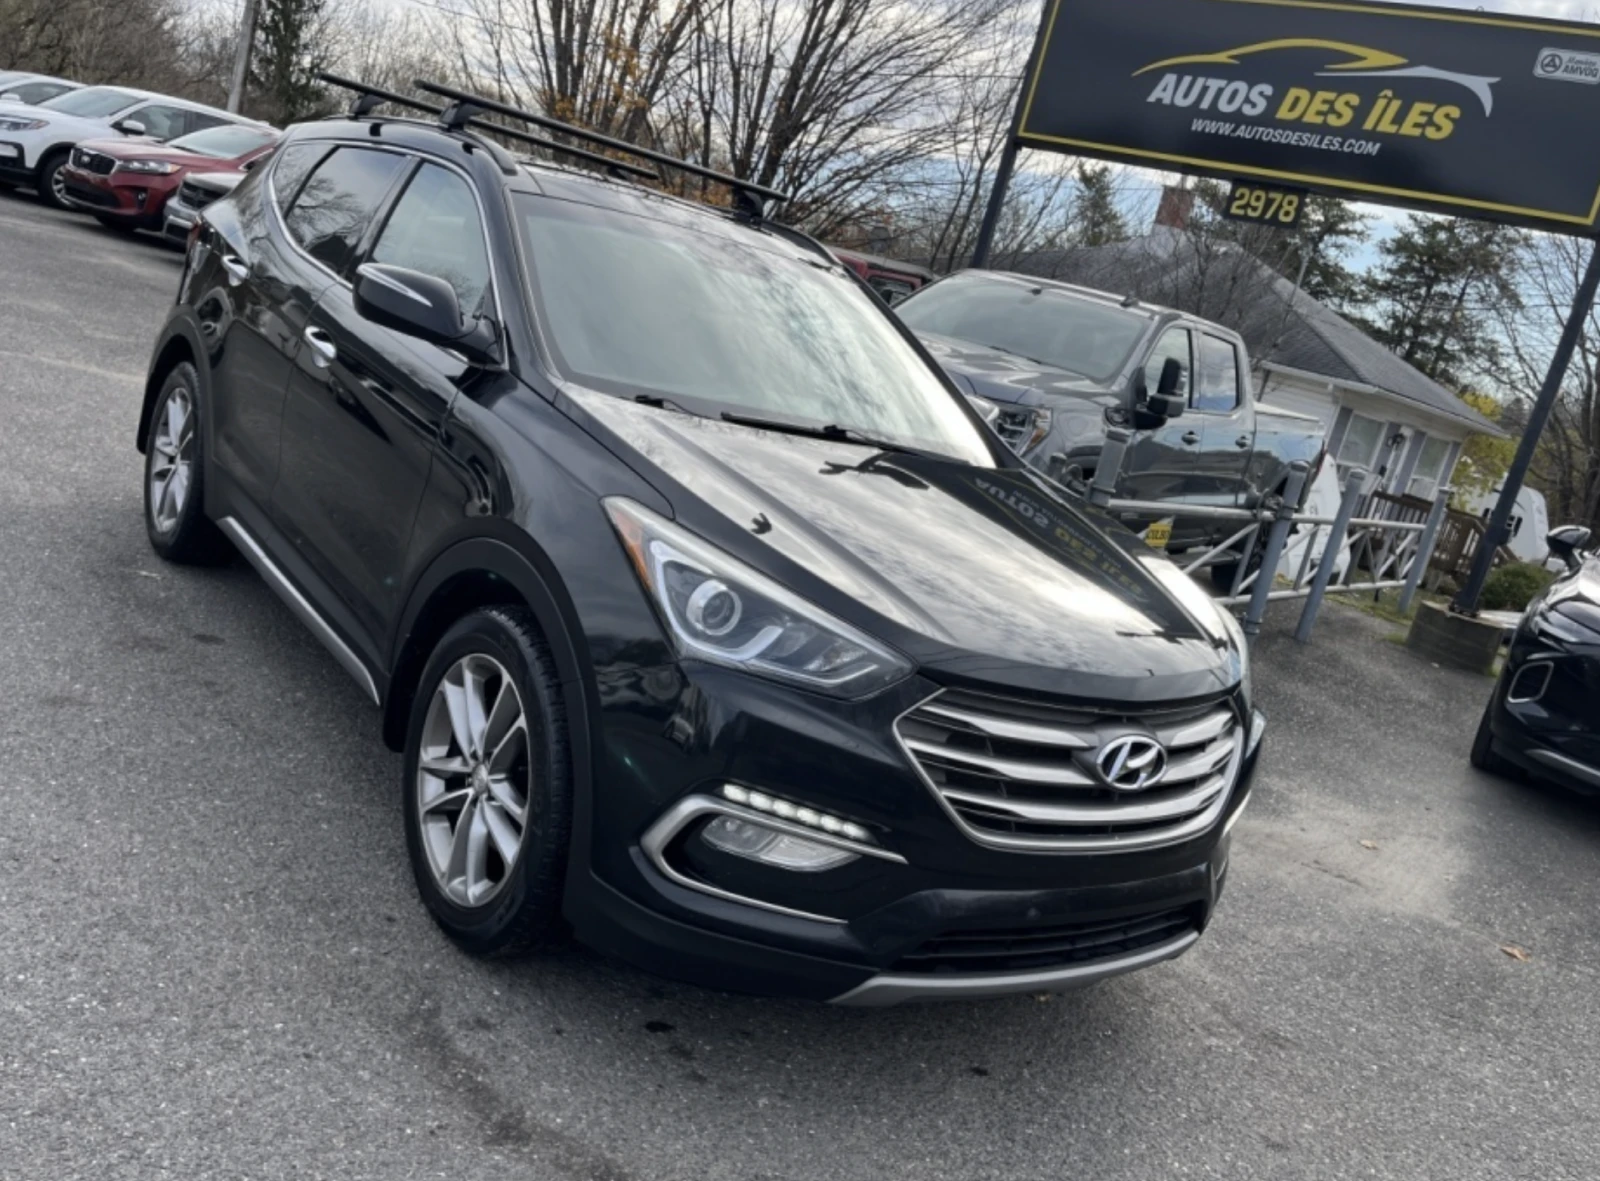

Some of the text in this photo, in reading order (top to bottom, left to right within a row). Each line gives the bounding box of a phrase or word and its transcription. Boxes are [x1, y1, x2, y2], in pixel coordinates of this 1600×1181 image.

[1146, 73, 1461, 140] AUTOS DES ÎLES
[1191, 118, 1381, 156] WWW.AUTOSDESILES.COM
[1230, 187, 1299, 222] 2978
